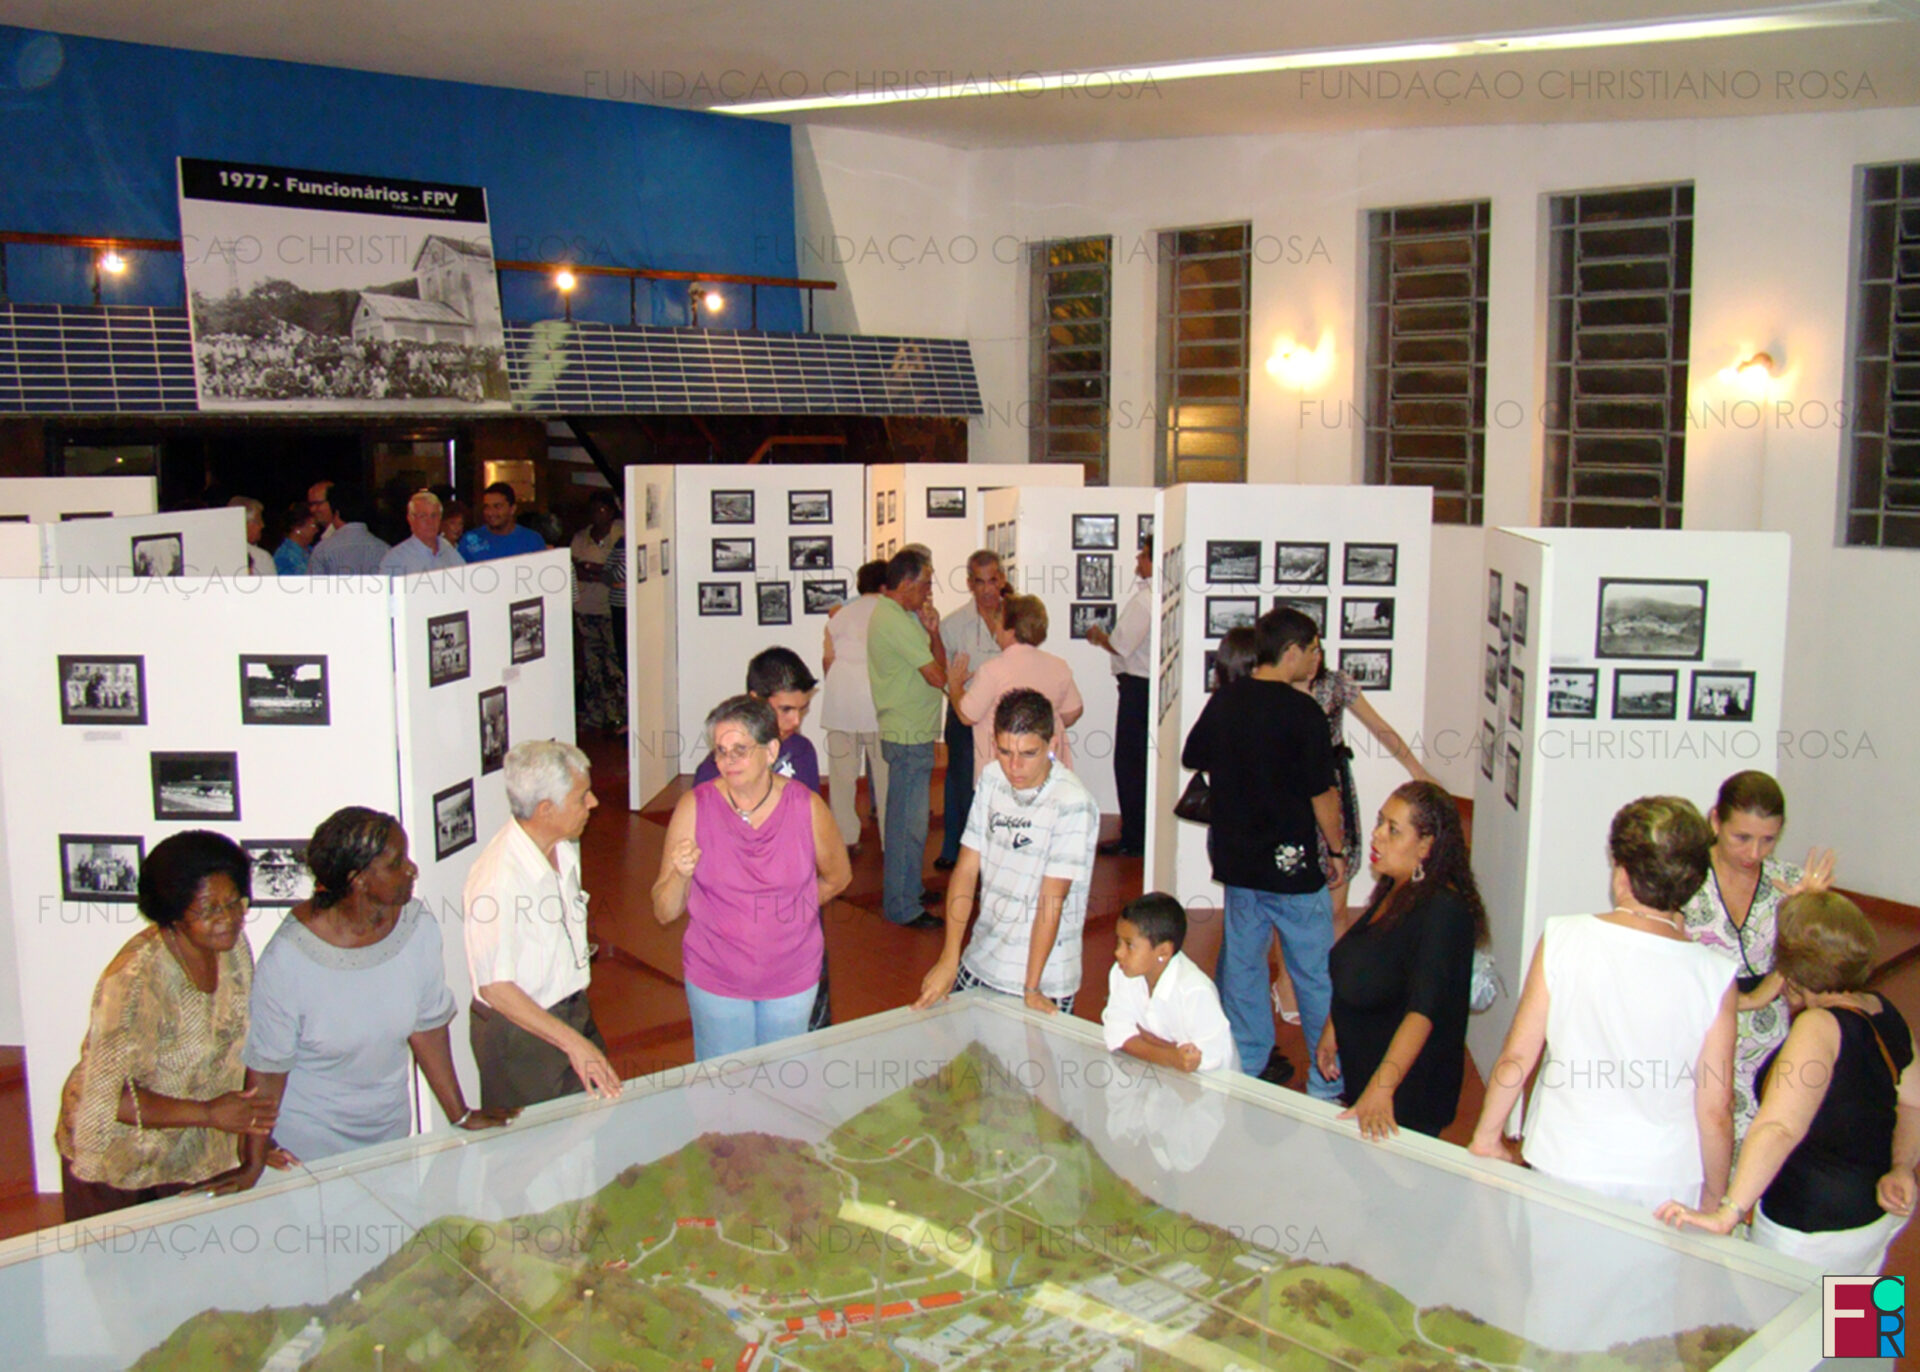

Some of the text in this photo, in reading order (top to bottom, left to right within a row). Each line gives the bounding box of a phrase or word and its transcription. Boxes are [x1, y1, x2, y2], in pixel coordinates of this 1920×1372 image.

[219, 171, 269, 190] 1977
[286, 177, 409, 203] Funcionários
[422, 191, 459, 207] FPV
